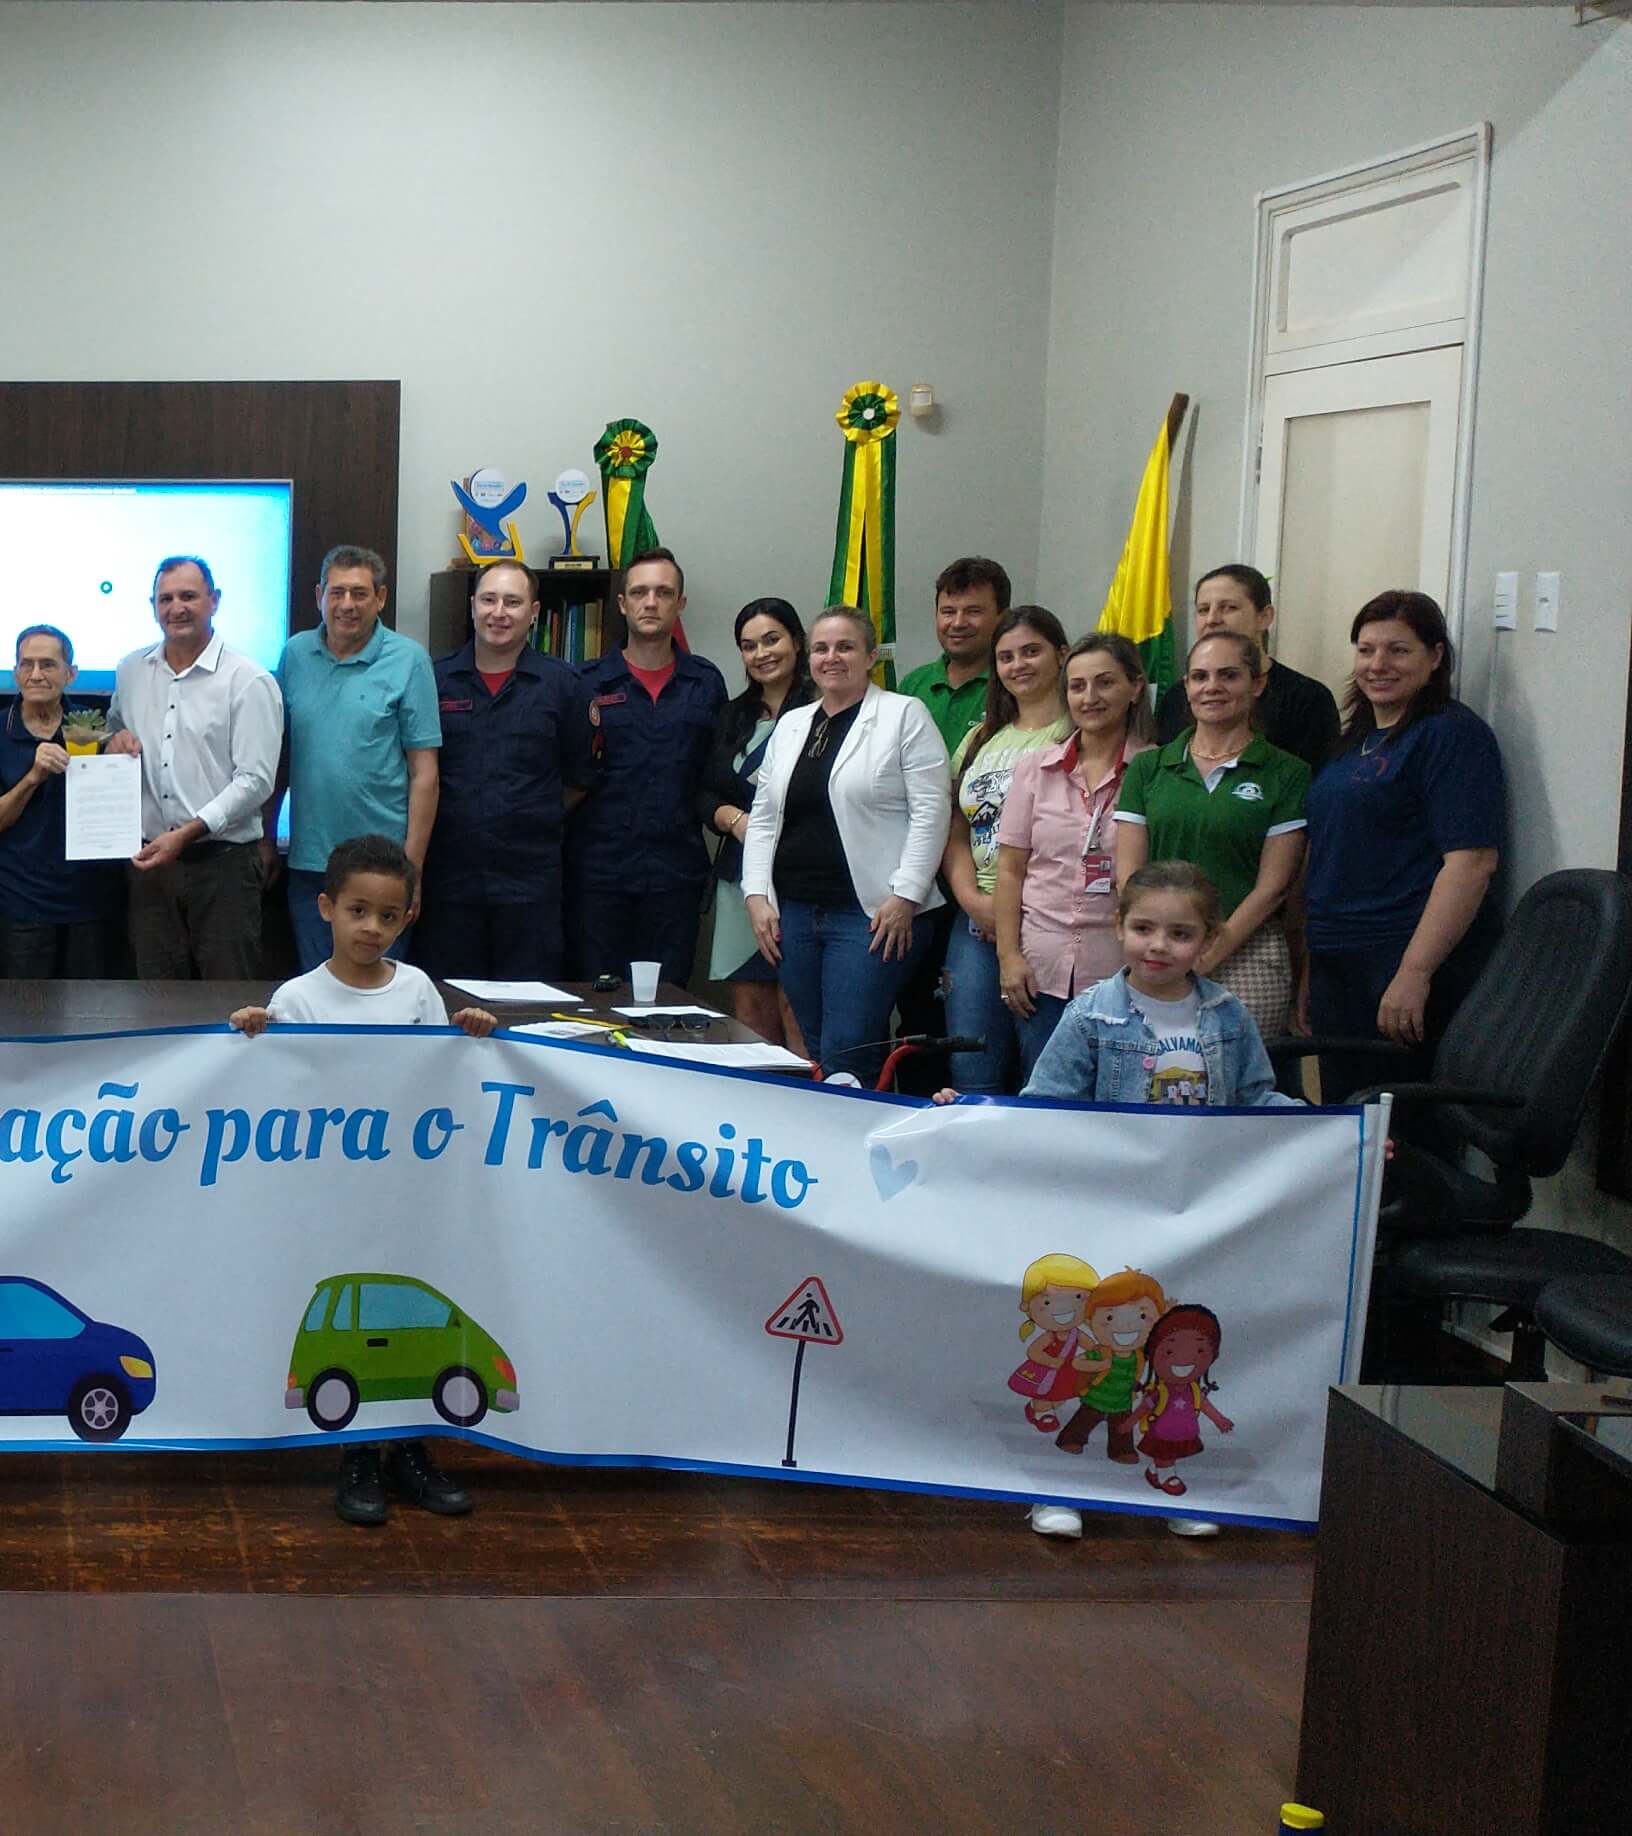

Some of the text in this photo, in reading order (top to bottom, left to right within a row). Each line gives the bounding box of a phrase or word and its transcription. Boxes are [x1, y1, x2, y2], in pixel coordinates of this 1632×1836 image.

[199, 1106, 391, 1187] para
[412, 1106, 465, 1161] o
[480, 1080, 819, 1210] Trânsito
